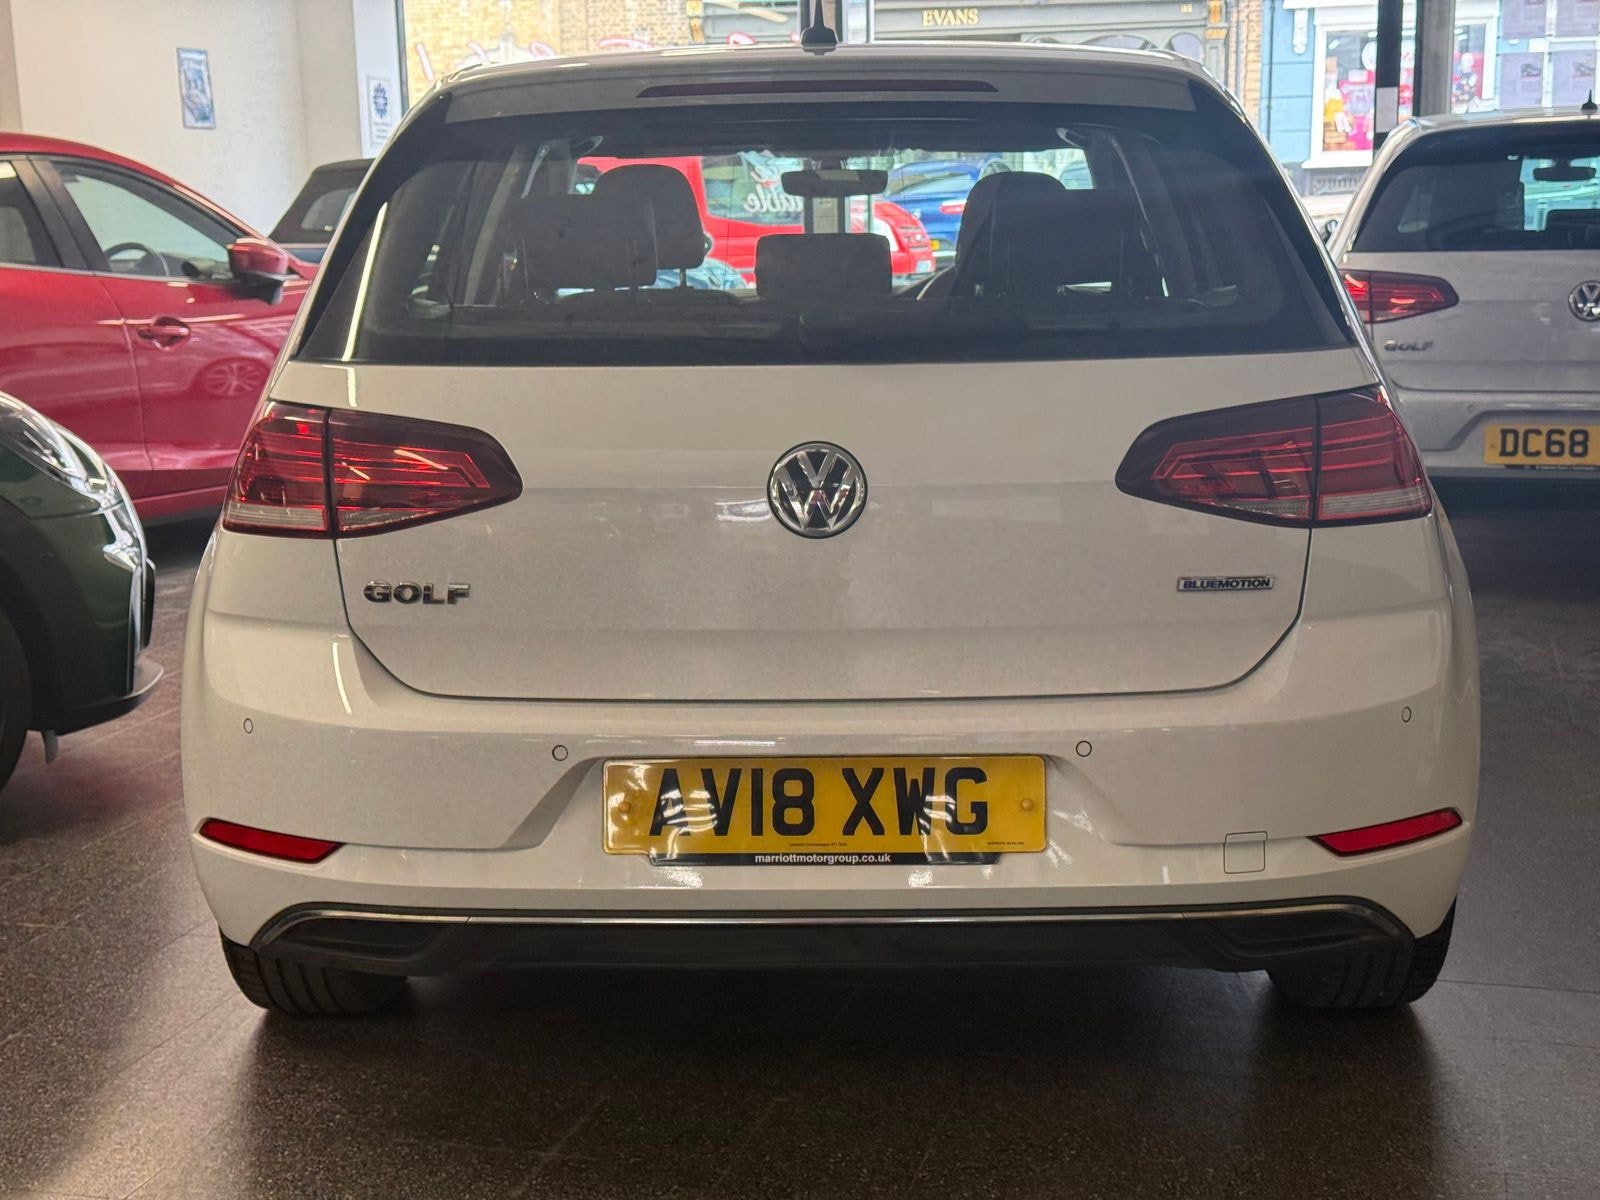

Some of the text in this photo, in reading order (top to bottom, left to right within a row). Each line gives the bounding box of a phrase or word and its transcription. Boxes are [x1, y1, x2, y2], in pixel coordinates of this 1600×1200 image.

[922, 8, 979, 27] EVANS
[1499, 428, 1589, 458] DC68
[363, 580, 470, 605] GOLF
[1183, 579, 1271, 589] BLUEMOTION
[650, 767, 988, 837] AV18 XWG
[754, 853, 891, 865] marriottmotorgroup.co.uk
